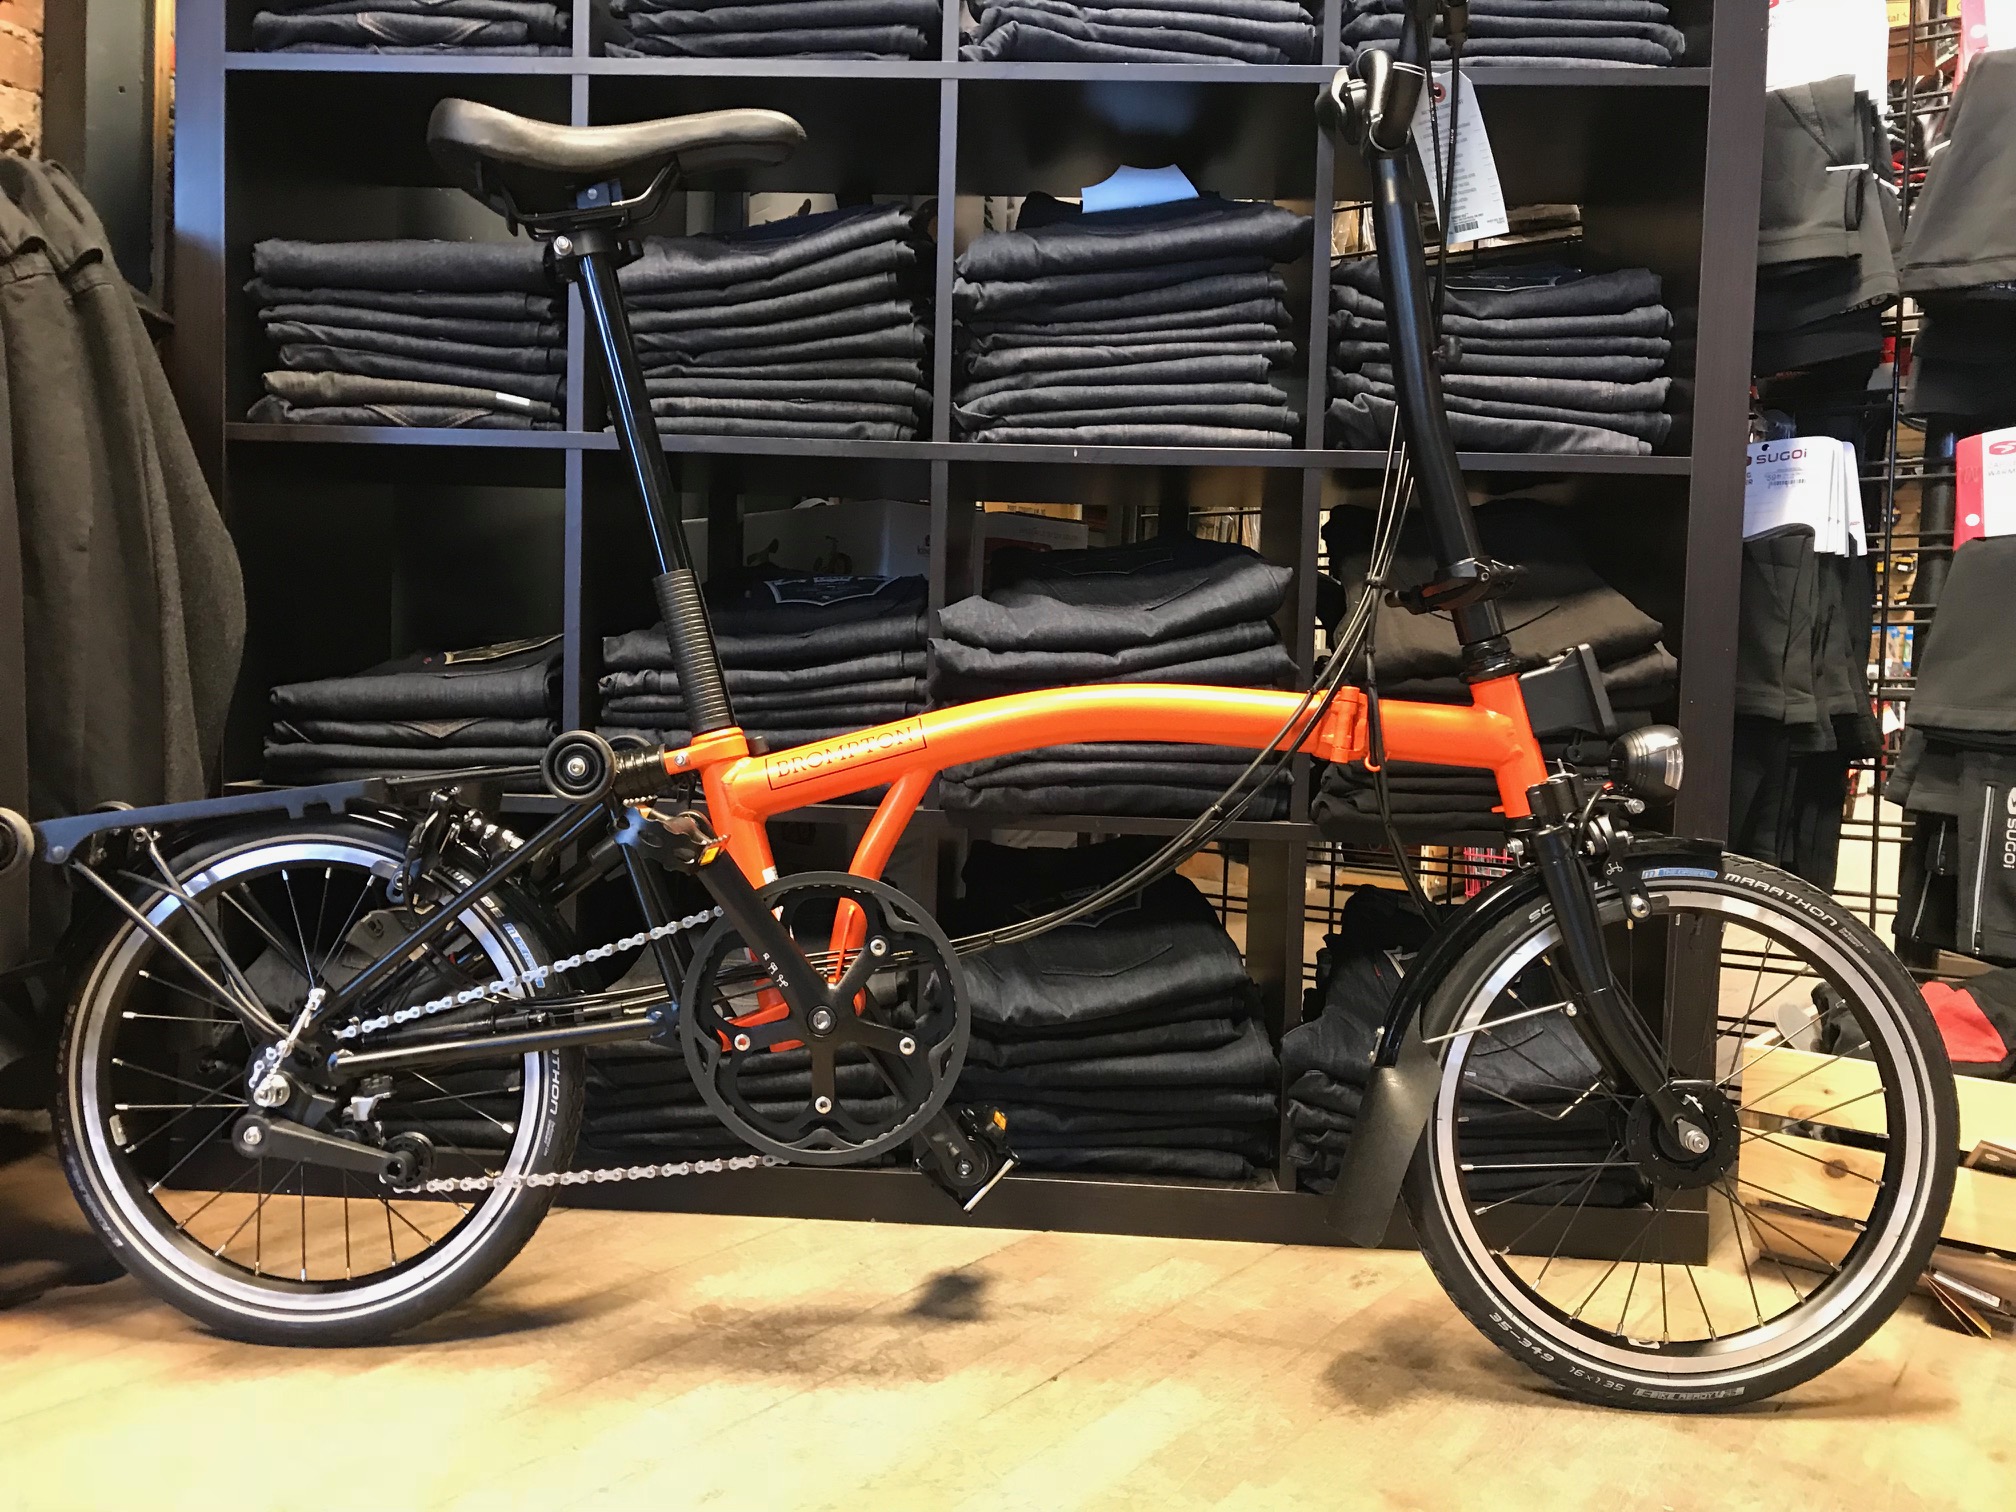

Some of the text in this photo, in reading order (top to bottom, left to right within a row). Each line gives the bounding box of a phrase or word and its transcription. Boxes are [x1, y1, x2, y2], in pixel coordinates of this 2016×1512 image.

[776, 725, 915, 778] BROMPTON
[1723, 872, 1839, 928] MARATHON
[1489, 1312, 1556, 1363] 35-349
